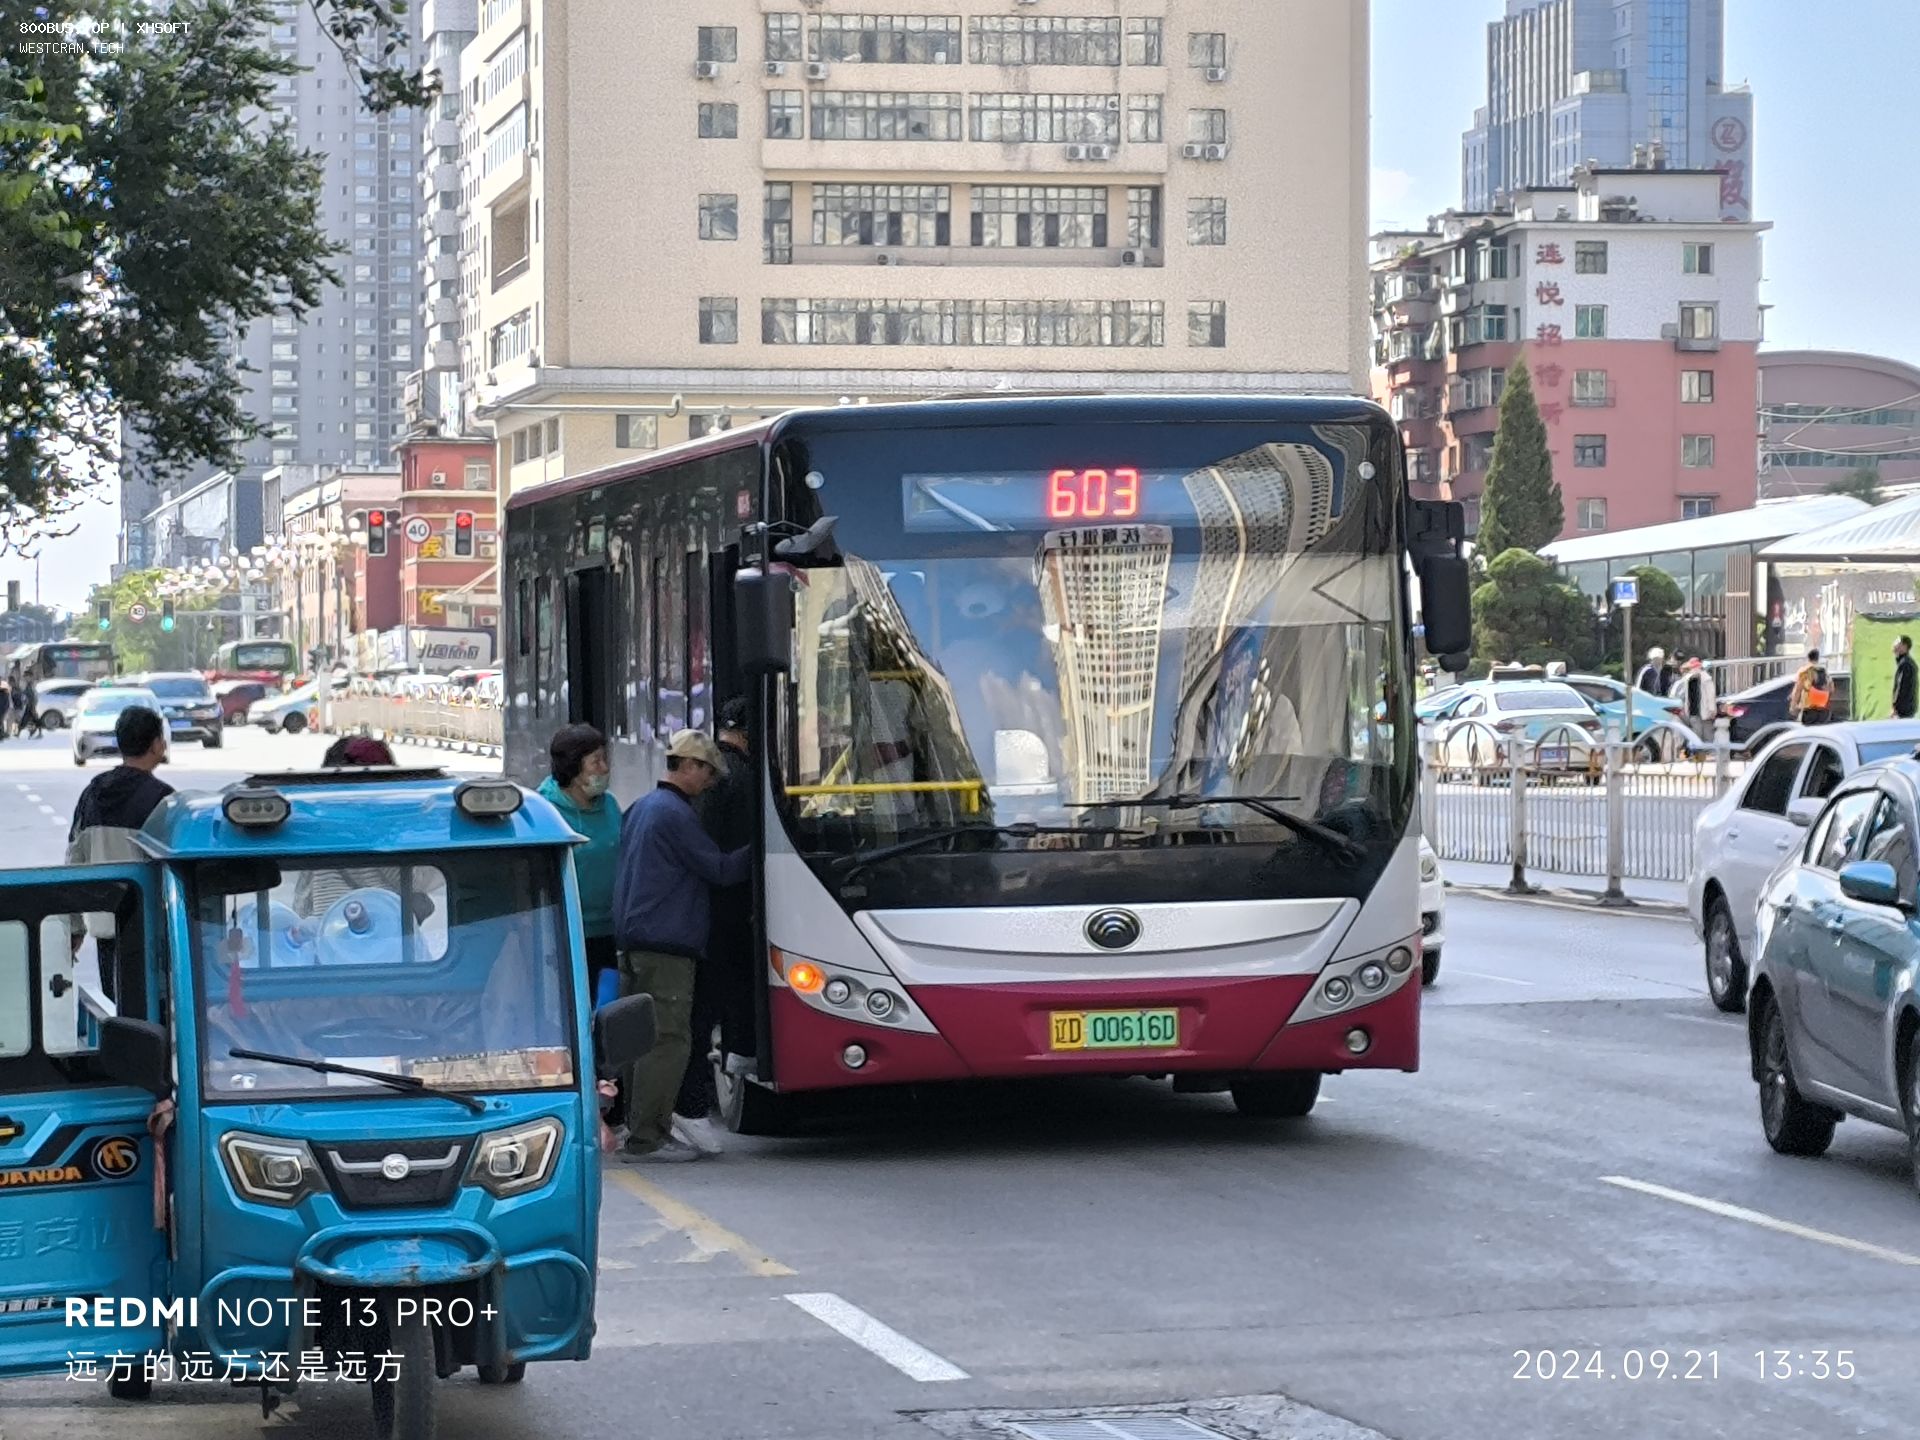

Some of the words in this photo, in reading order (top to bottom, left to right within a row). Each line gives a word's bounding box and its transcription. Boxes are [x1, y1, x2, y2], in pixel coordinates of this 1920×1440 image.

[1050, 469, 1139, 517] 603
[408, 523, 427, 537] 40
[1093, 1014, 1175, 1042] 00616D
